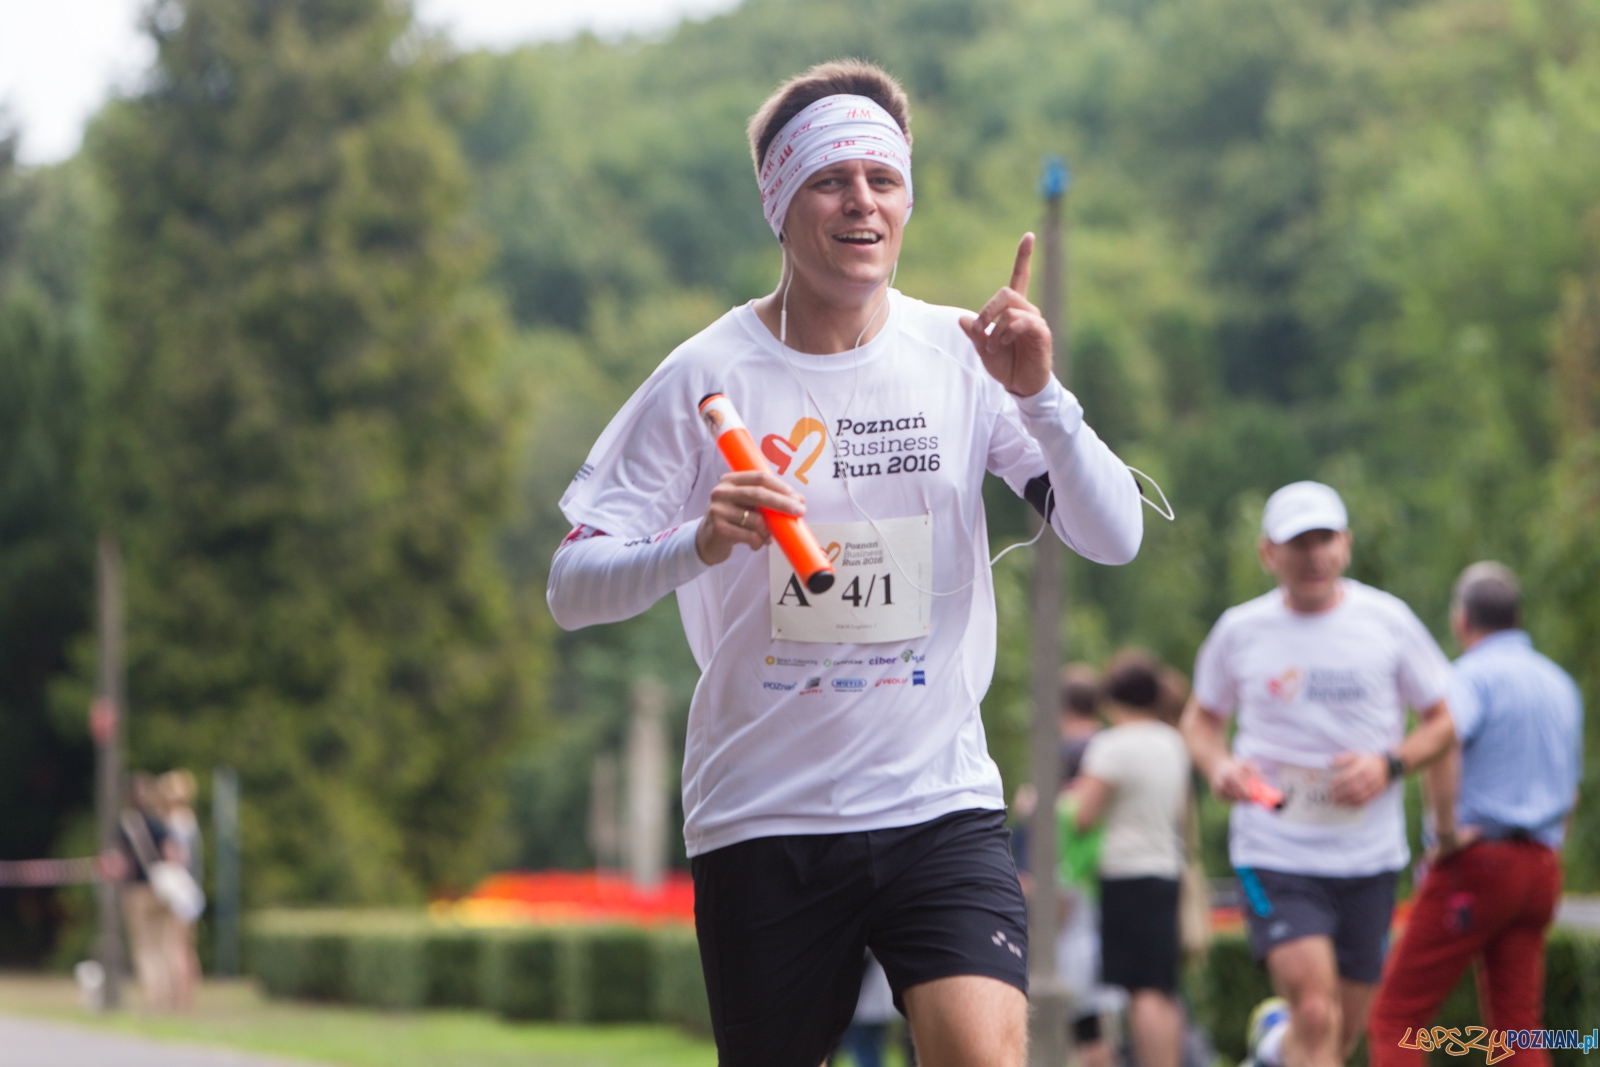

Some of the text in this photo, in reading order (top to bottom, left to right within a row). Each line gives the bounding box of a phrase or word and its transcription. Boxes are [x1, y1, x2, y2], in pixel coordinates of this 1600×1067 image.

[836, 412, 927, 436] Poznań
[834, 436, 939, 458] Business
[832, 454, 941, 479] Run 2016
[843, 549, 883, 558] Business
[845, 541, 878, 550] Poznań
[842, 556, 883, 566] Run 2016
[776, 572, 895, 607] A 4/1
[869, 656, 897, 665] ciber
